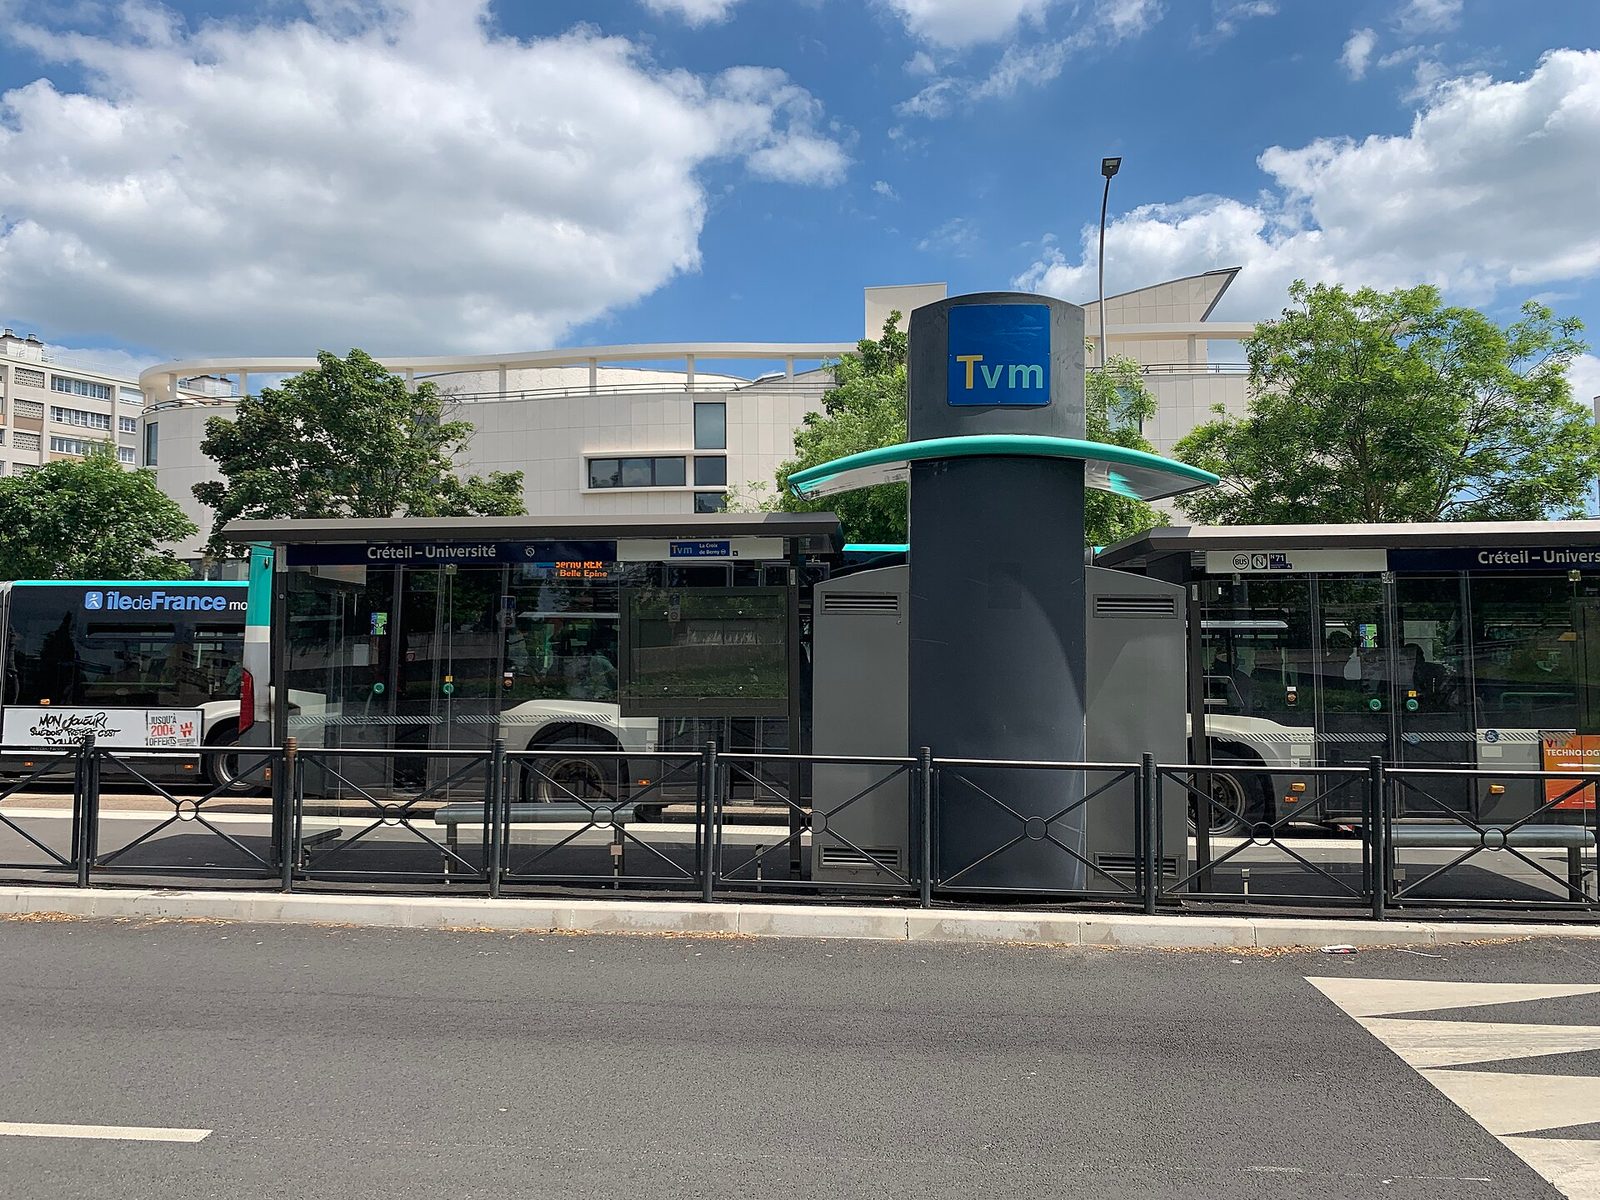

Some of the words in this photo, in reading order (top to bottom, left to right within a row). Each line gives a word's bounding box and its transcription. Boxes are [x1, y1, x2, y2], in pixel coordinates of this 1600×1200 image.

[956, 354, 1044, 390] Tvm
[367, 546, 413, 559] Créteil
[425, 545, 497, 558] Université
[671, 544, 693, 554] Tvm
[1234, 558, 1248, 566] BUS
[1478, 550, 1529, 564] Créteil
[559, 569, 582, 577] Belle
[38, 713, 63, 728] MON
[151, 724, 176, 737] 200€
[1545, 749, 1600, 757] TECHNOLOG
